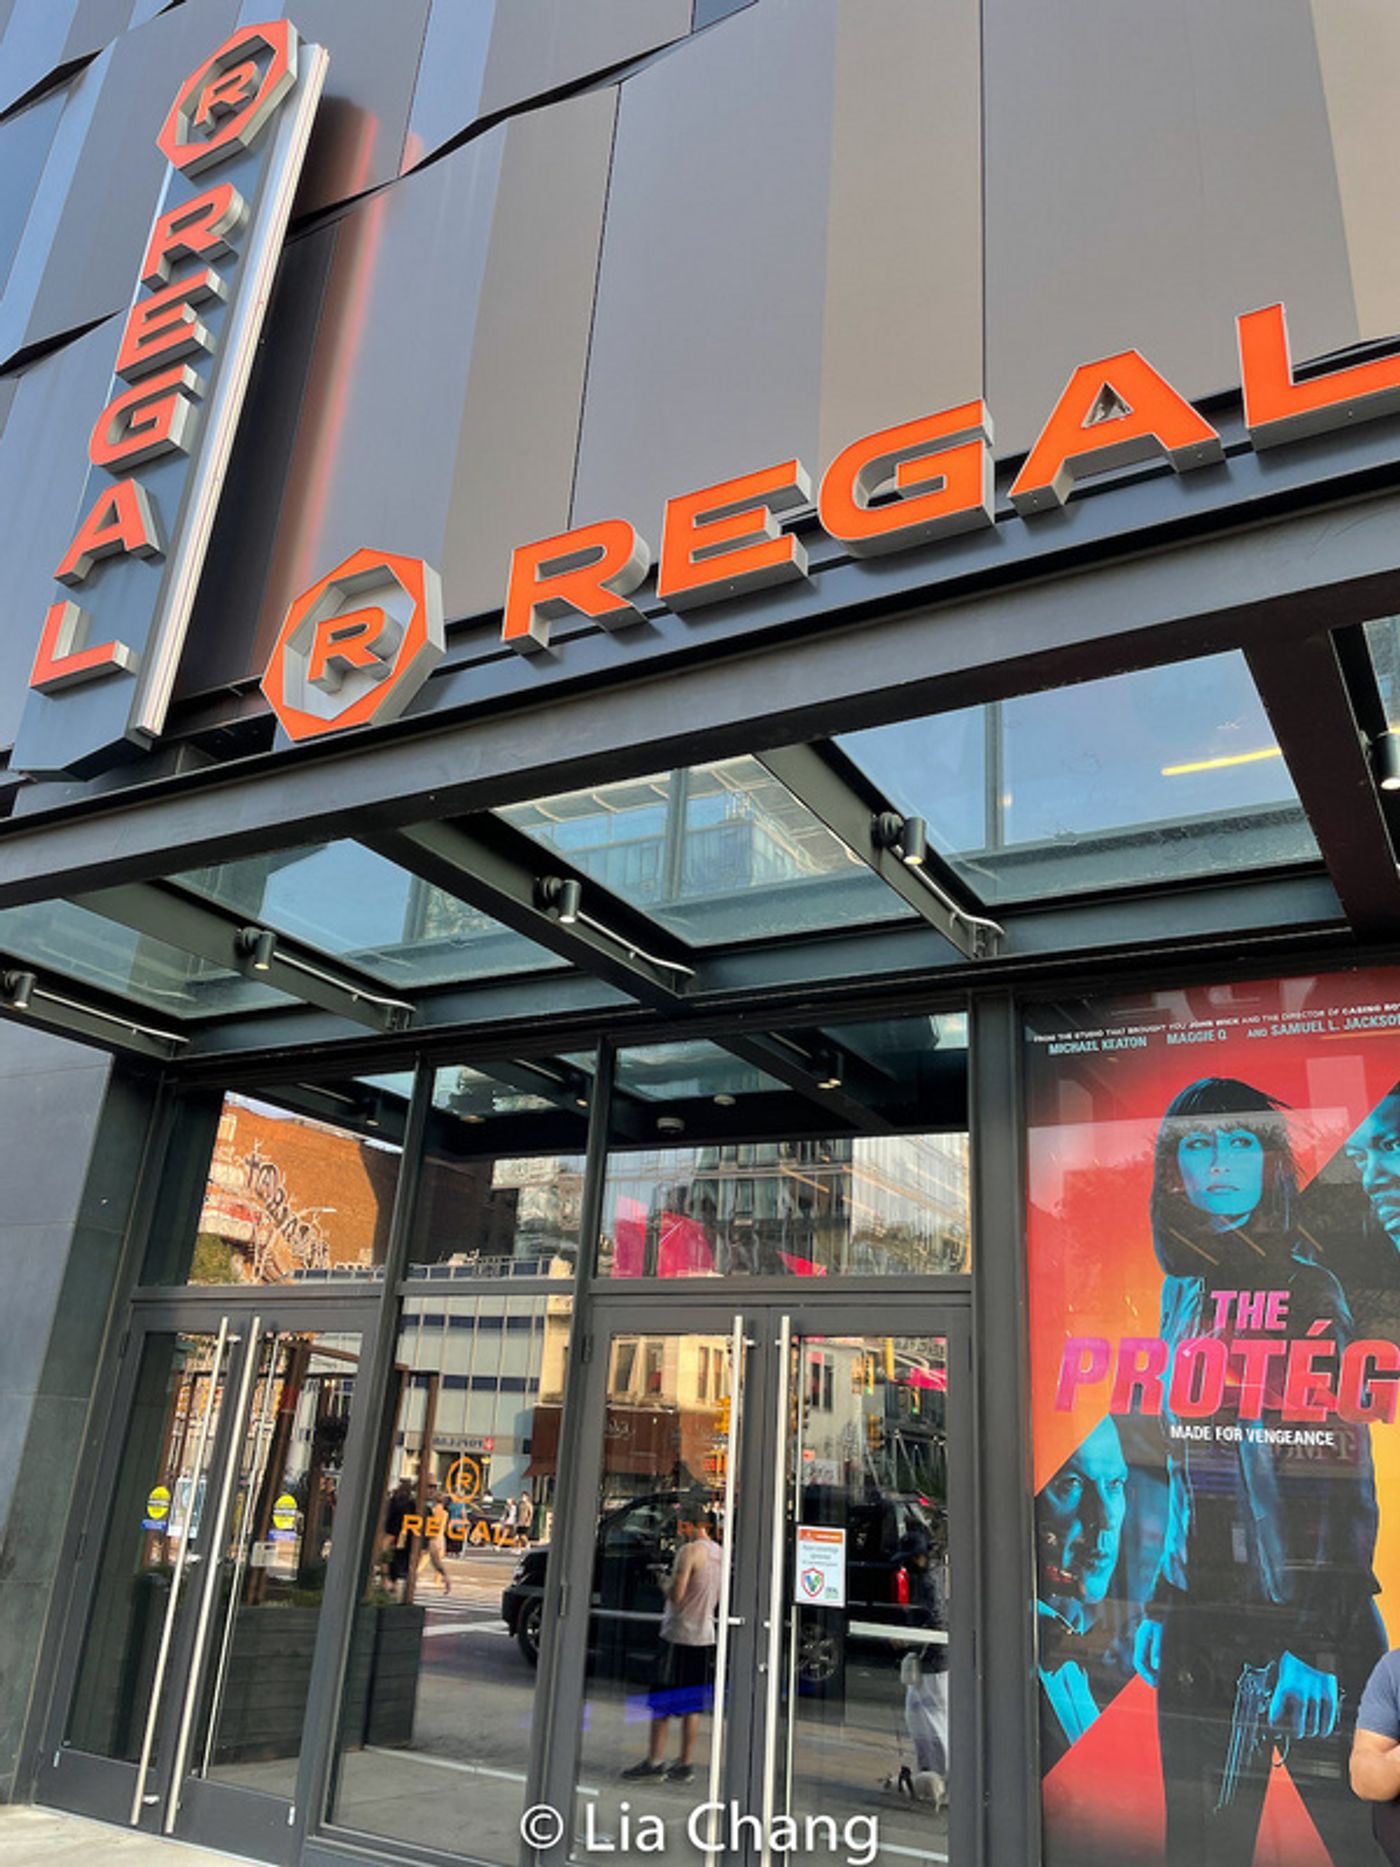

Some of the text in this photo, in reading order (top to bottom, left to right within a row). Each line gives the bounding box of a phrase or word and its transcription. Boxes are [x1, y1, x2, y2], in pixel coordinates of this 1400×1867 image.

[194, 61, 259, 126] R
[30, 183, 244, 694] REGAL
[502, 303, 1400, 643] REGAL
[307, 605, 388, 686] R
[1241, 1015, 1261, 1024] AND
[1262, 1013, 1279, 1022] THE
[1281, 1009, 1325, 1021] DIRECTOR
[1327, 1006, 1340, 1017] OF
[1341, 1003, 1382, 1015] CASINO
[1048, 1040, 1100, 1056] MICHAEL
[1101, 1036, 1148, 1051] KEATON
[1167, 1030, 1216, 1045] MAGGIE
[1217, 1028, 1228, 1041] Q
[1247, 1027, 1268, 1038] AND
[1270, 1018, 1326, 1037] SAMUEL
[1327, 1020, 1341, 1032] L.
[1210, 1290, 1291, 1331] THE
[1170, 1425, 1213, 1442] MADE
[1215, 1426, 1244, 1442] FOR
[1245, 1428, 1336, 1447] VENGEANCE
[400, 1513, 518, 1547] REGAL
